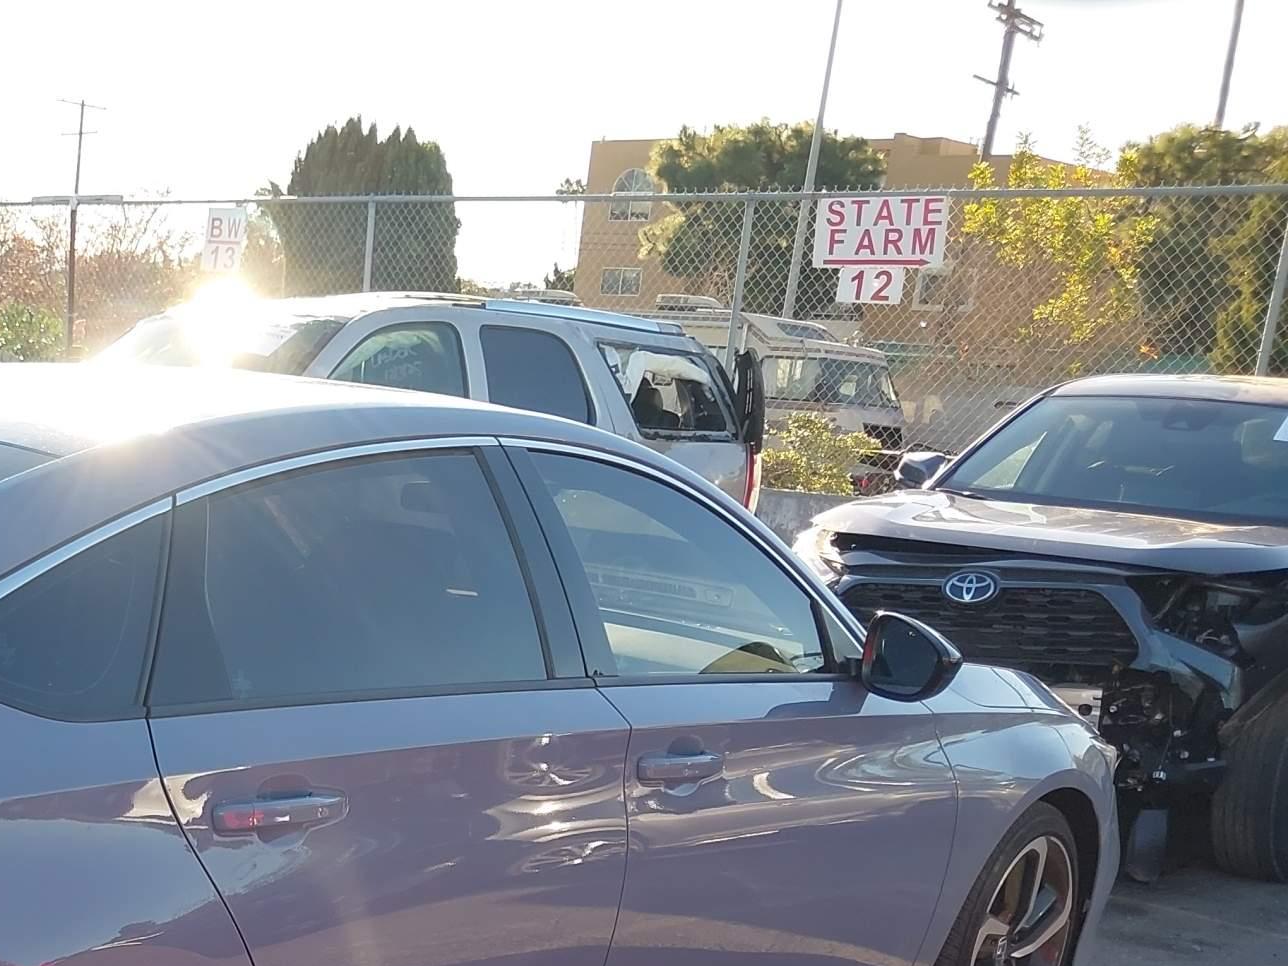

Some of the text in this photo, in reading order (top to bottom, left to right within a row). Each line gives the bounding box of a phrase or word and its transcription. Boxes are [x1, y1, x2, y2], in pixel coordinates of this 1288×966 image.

[826, 198, 944, 227] STATE
[210, 217, 241, 239] BW
[828, 227, 936, 256] FARM
[211, 245, 236, 269] 13
[850, 270, 893, 301] 12
